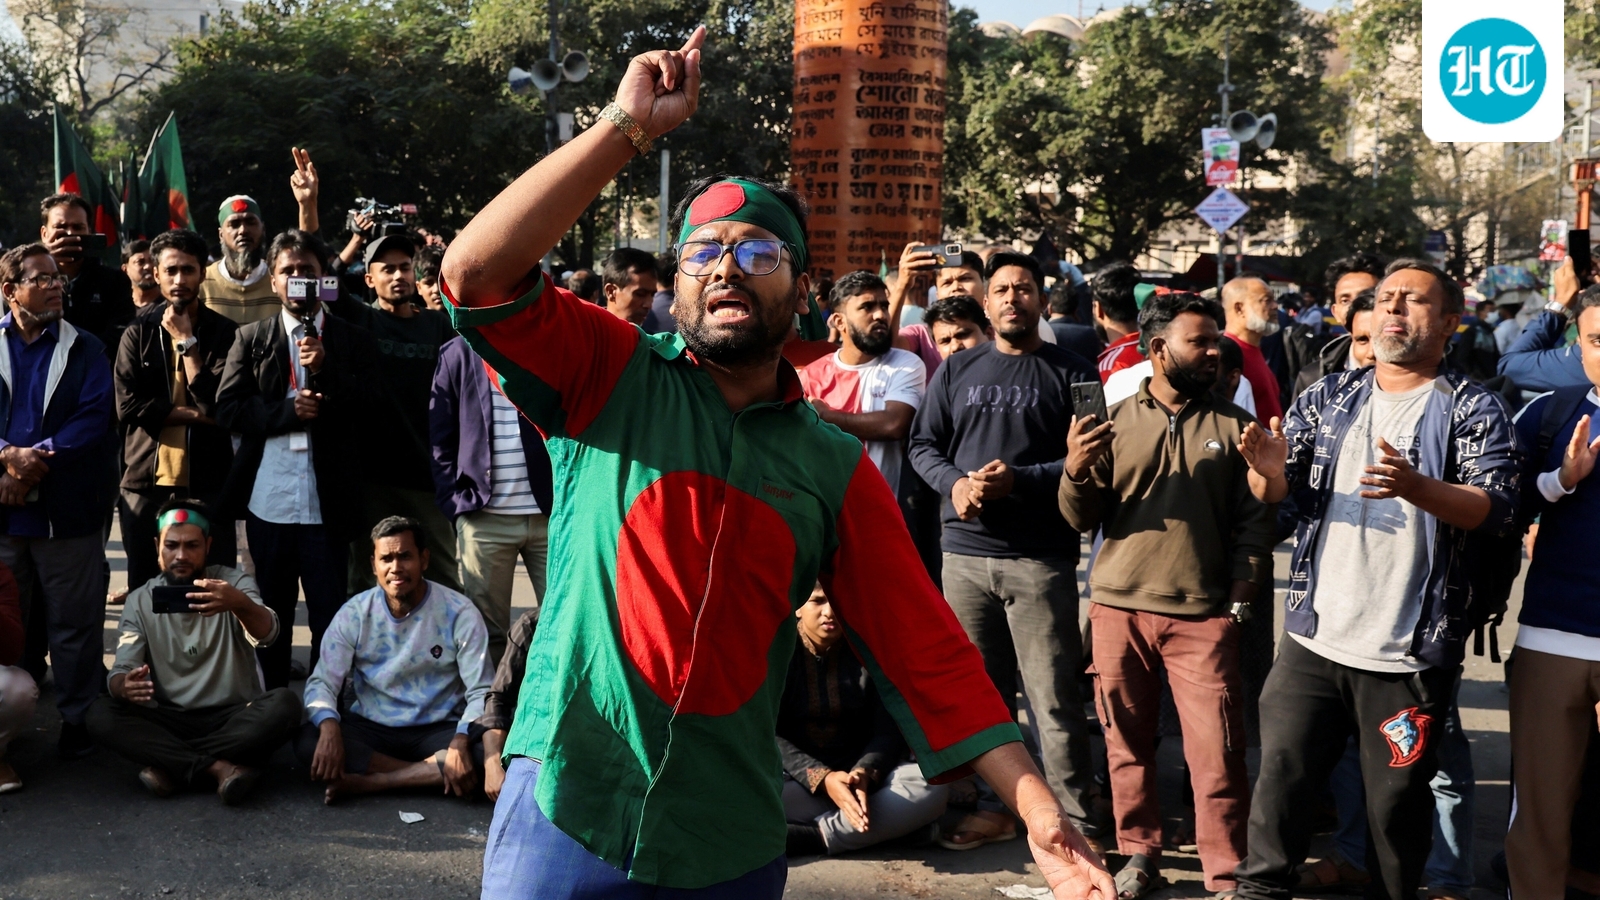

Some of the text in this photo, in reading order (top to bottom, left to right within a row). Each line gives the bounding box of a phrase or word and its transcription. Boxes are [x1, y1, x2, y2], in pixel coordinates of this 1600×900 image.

[856, 85, 918, 104] শোনো
[856, 105, 909, 120] আমরা
[965, 384, 1040, 408] MOOD
